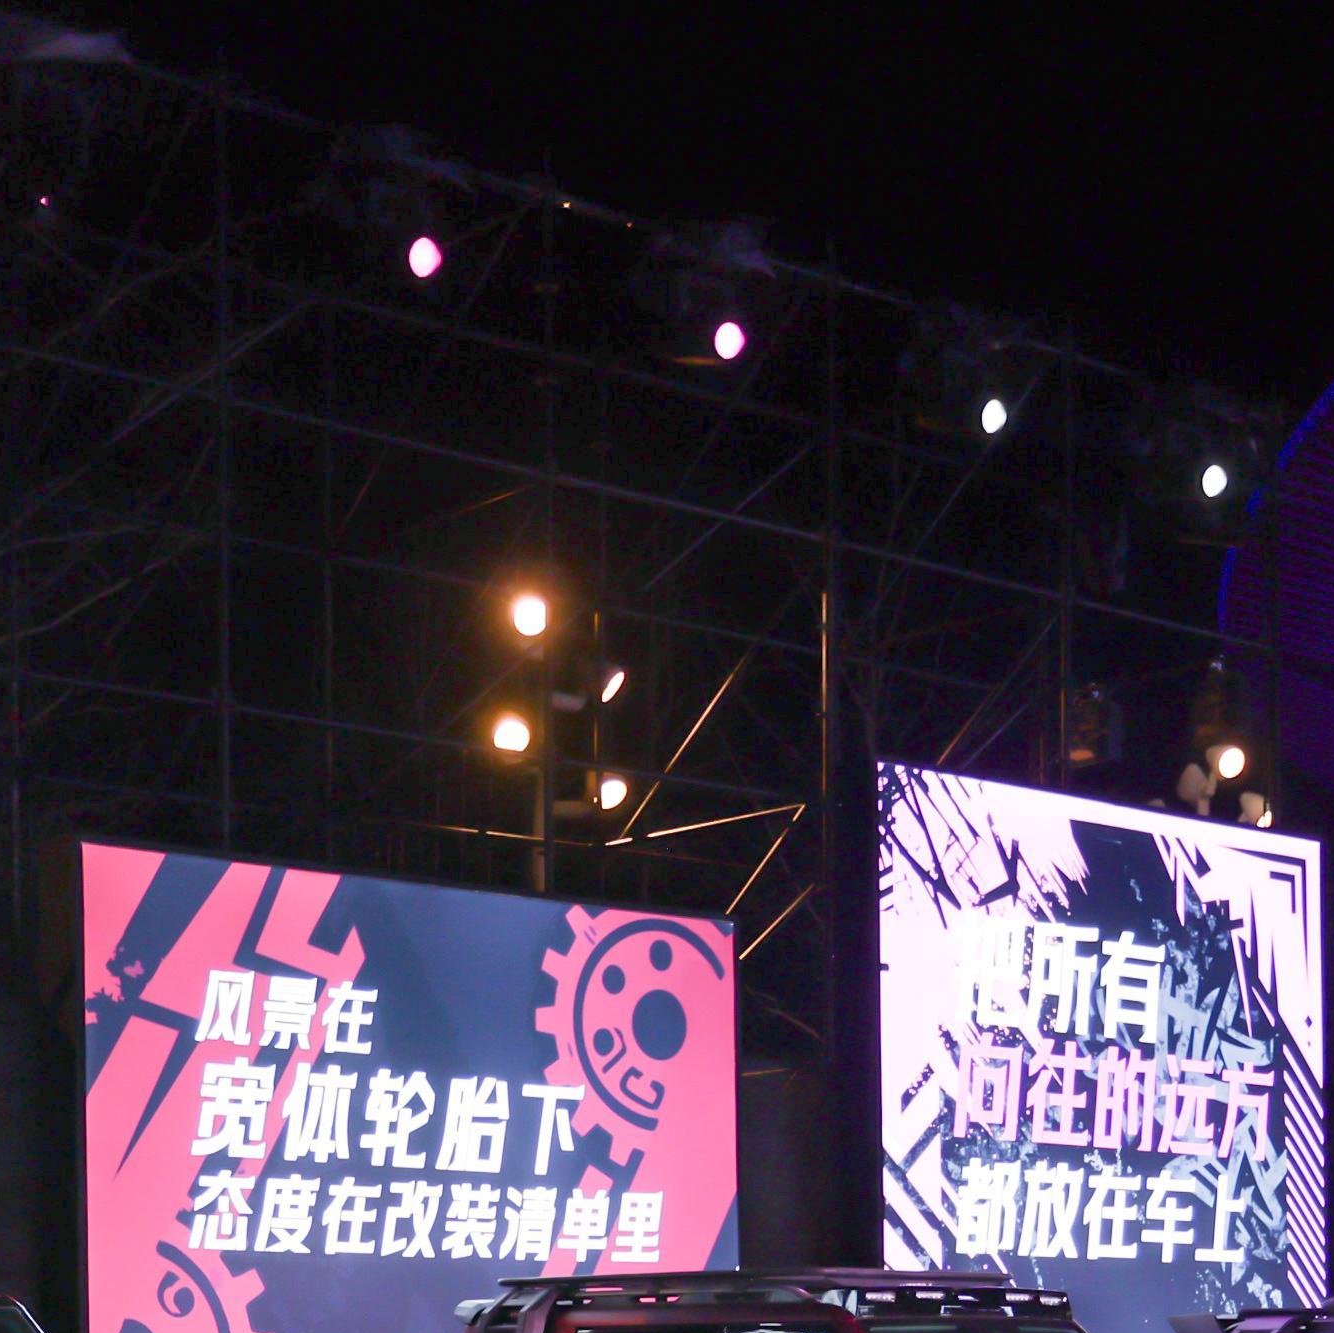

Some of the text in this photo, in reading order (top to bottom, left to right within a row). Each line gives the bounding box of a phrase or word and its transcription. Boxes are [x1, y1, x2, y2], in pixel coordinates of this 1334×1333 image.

[194, 969, 379, 1054] 风景在
[954, 908, 1166, 1044] 把所有
[190, 1056, 585, 1176] 宽体轮胎下
[952, 1033, 1276, 1162] 向往的远方
[187, 1169, 664, 1263] 态度在改装清单里
[954, 1157, 1247, 1264] 都放在车上
